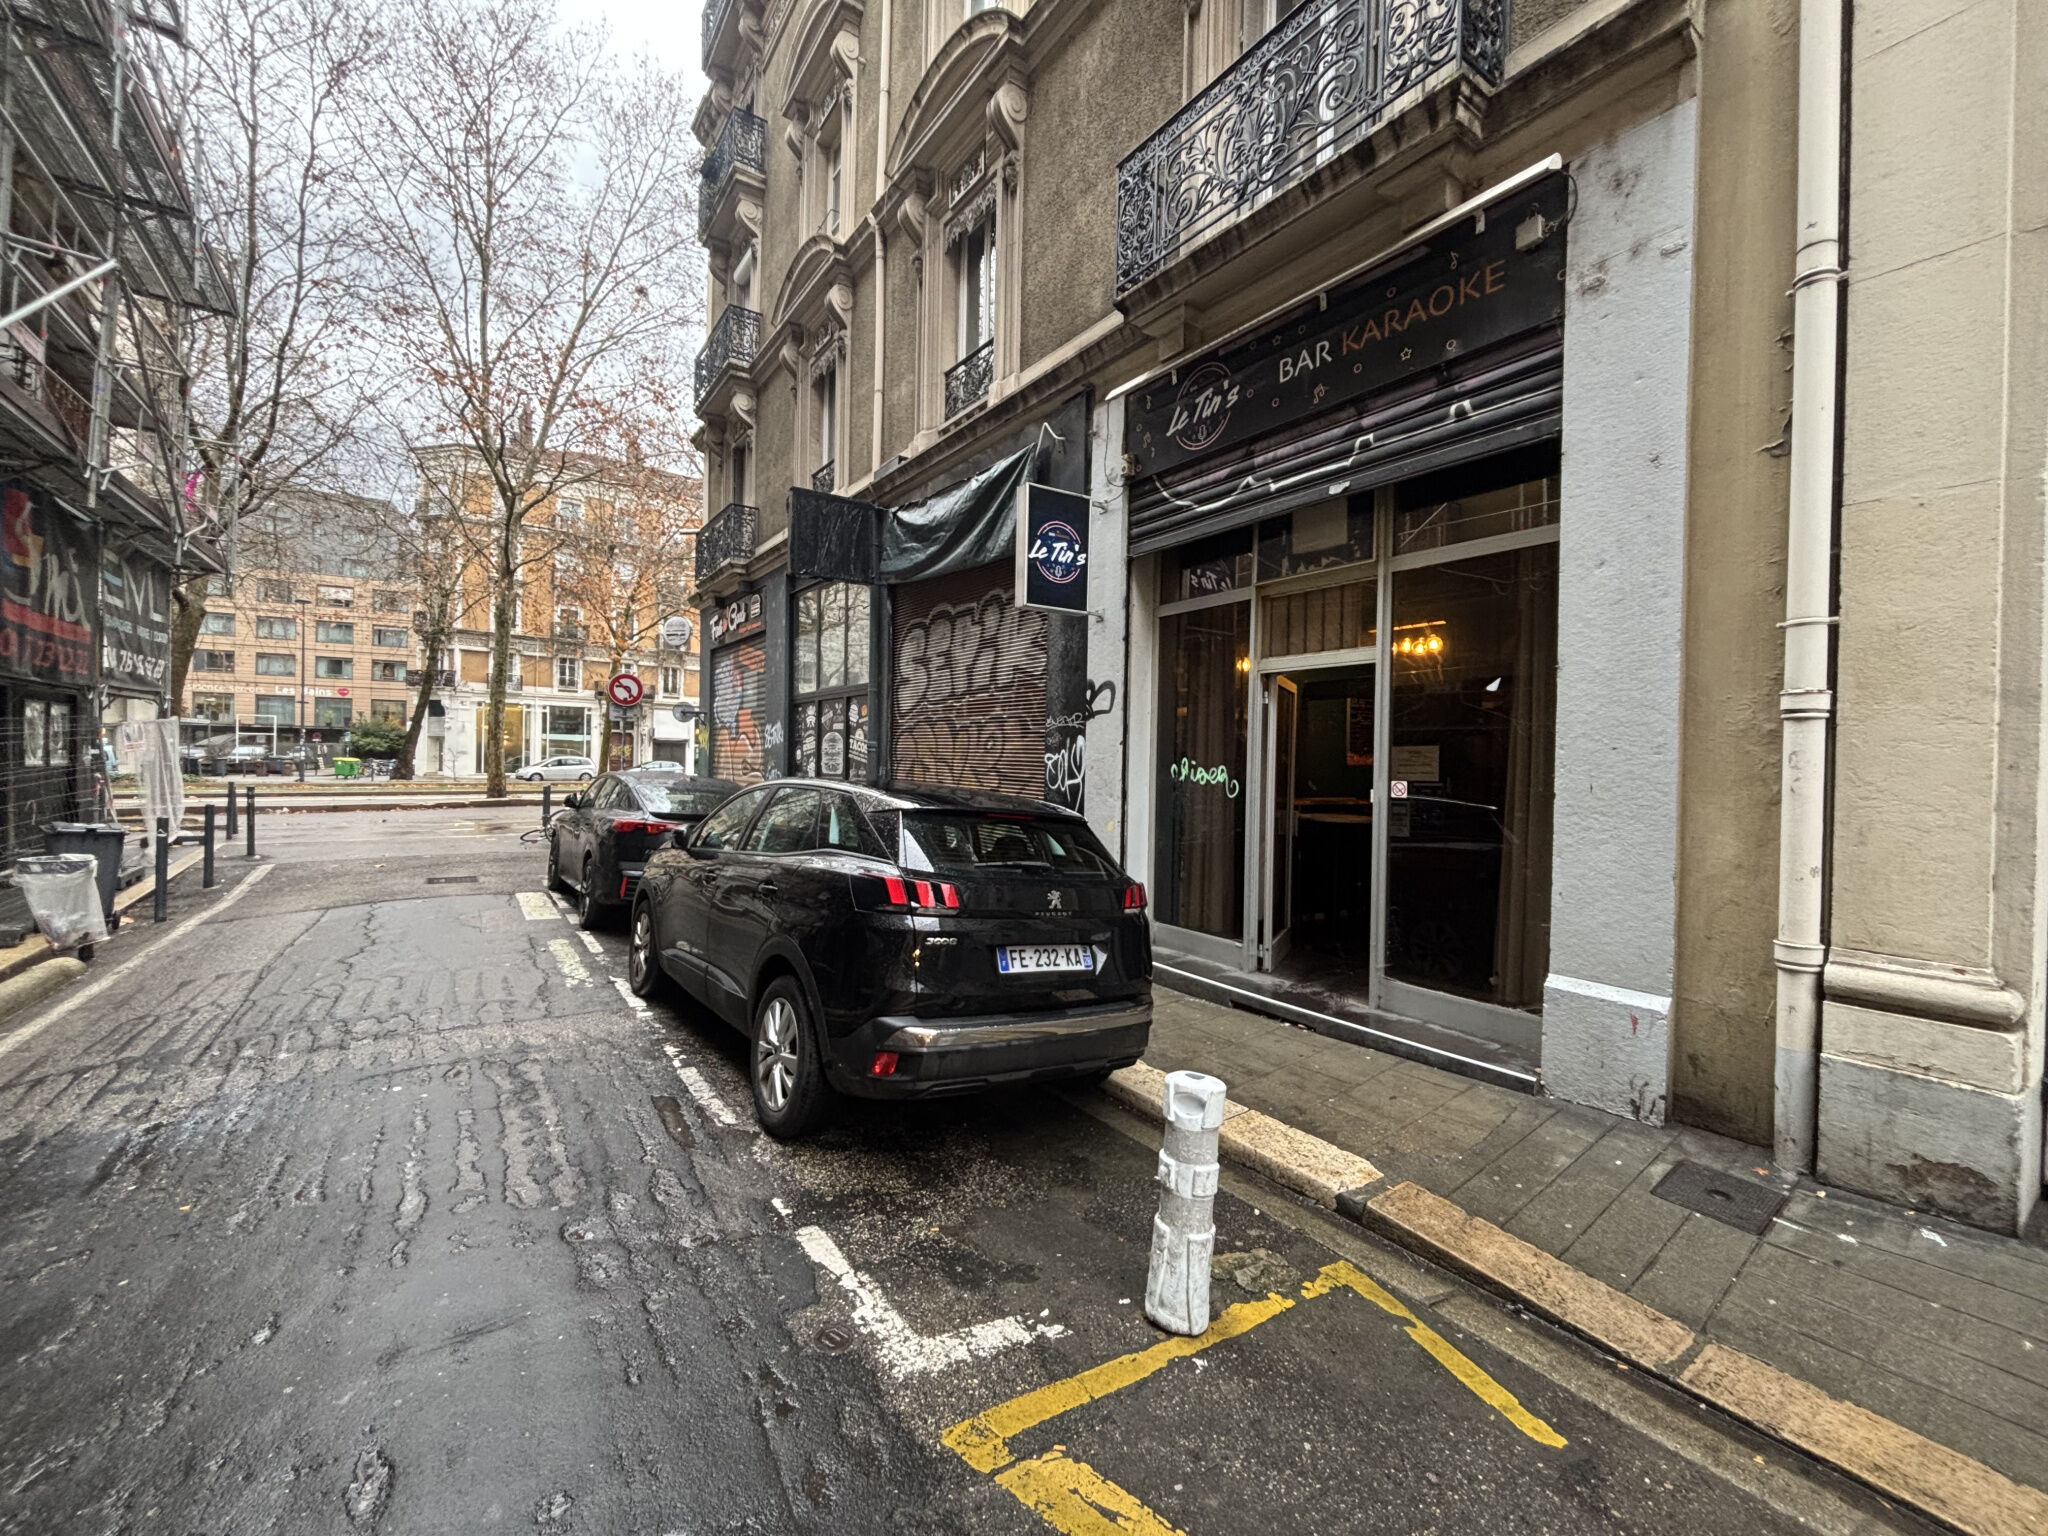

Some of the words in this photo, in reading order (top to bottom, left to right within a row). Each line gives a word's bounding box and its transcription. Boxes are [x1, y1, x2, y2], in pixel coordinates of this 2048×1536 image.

[1279, 341, 1333, 384] BAR
[1340, 259, 1506, 356] KARAOKE
[1165, 406, 1190, 437] Le
[1193, 379, 1240, 424] Tin's
[1028, 539, 1049, 559] Le
[1051, 542, 1087, 566] Tin's
[275, 685, 295, 695] Les
[1010, 948, 1083, 969] FE-232-KA
